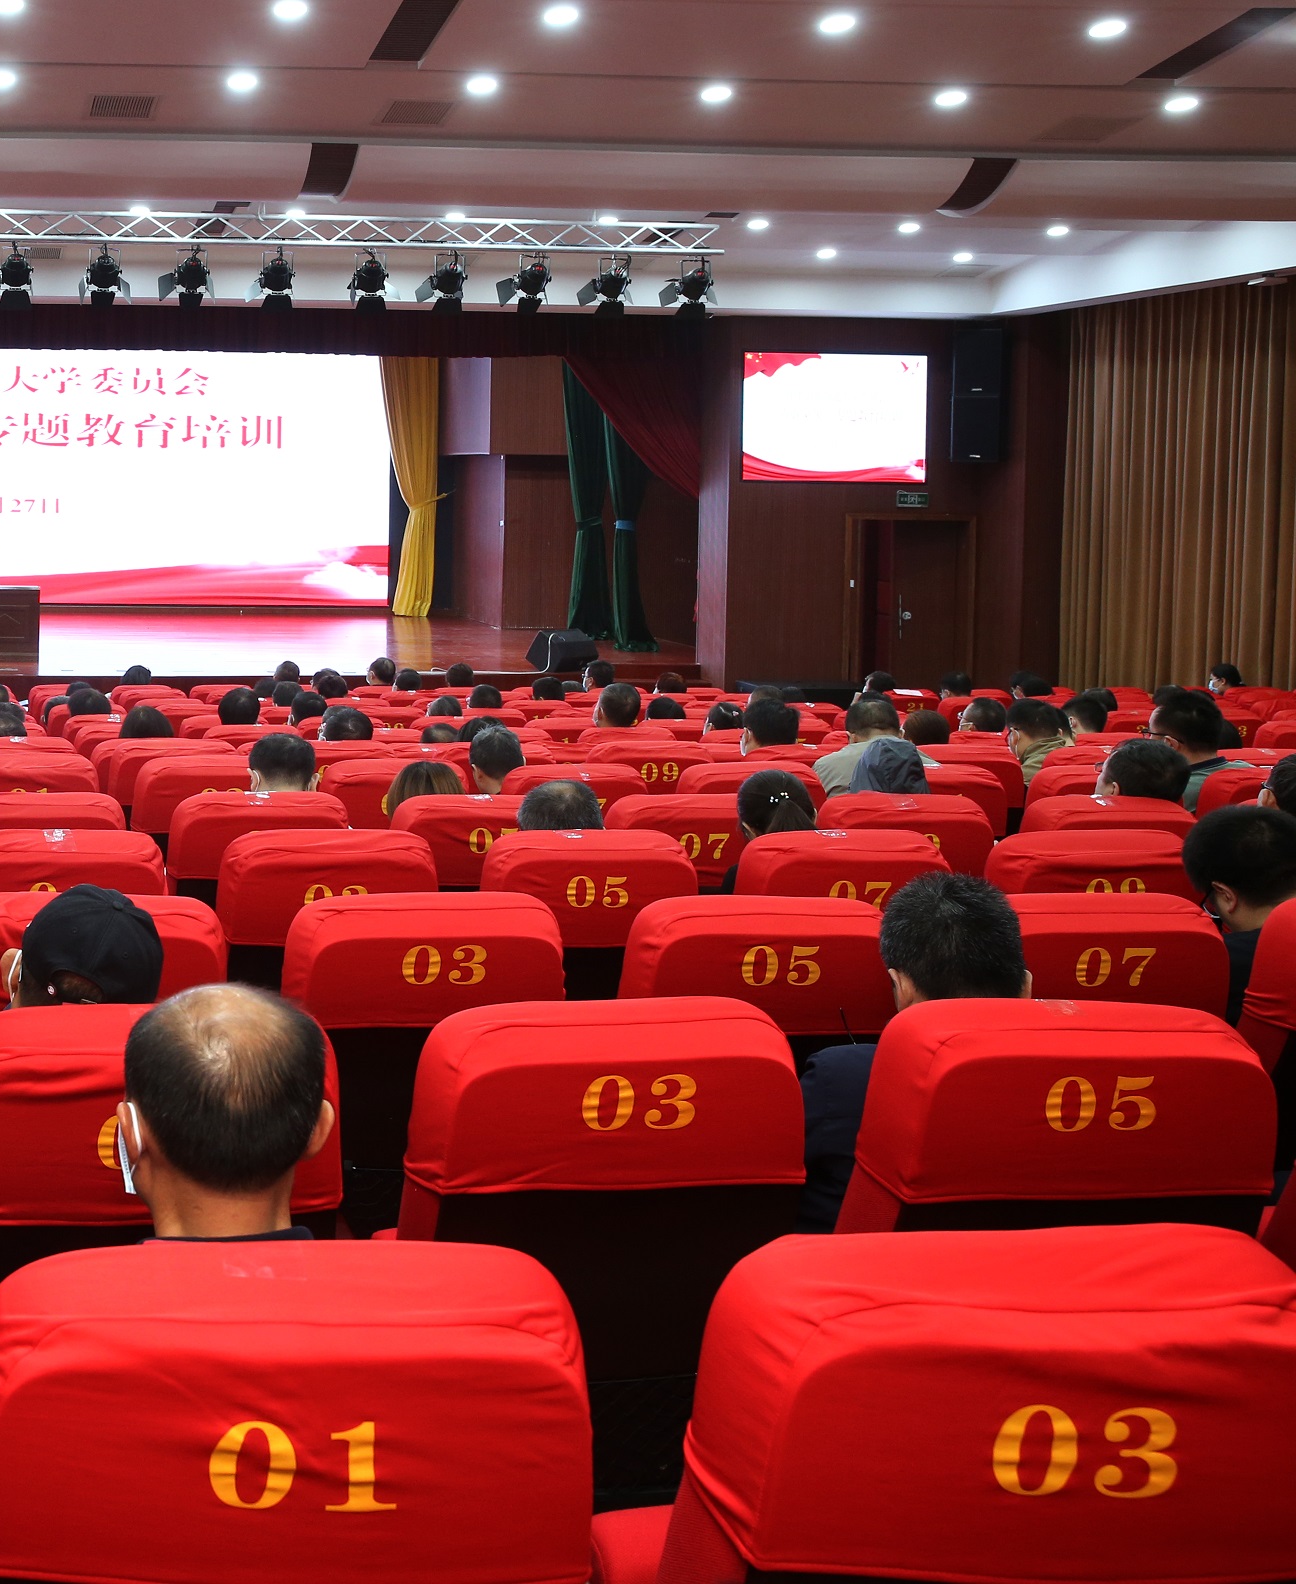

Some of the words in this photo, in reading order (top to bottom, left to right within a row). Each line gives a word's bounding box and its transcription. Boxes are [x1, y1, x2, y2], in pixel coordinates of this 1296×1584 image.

[640, 762, 679, 783] 09
[678, 833, 730, 860] 07
[566, 875, 628, 908] 05
[401, 944, 487, 985] 03
[741, 945, 821, 986] 05
[1075, 947, 1157, 987] 07
[582, 1073, 697, 1131] 03
[1045, 1076, 1157, 1132] 05
[209, 1420, 397, 1512] 01
[992, 1404, 1178, 1499] 03
